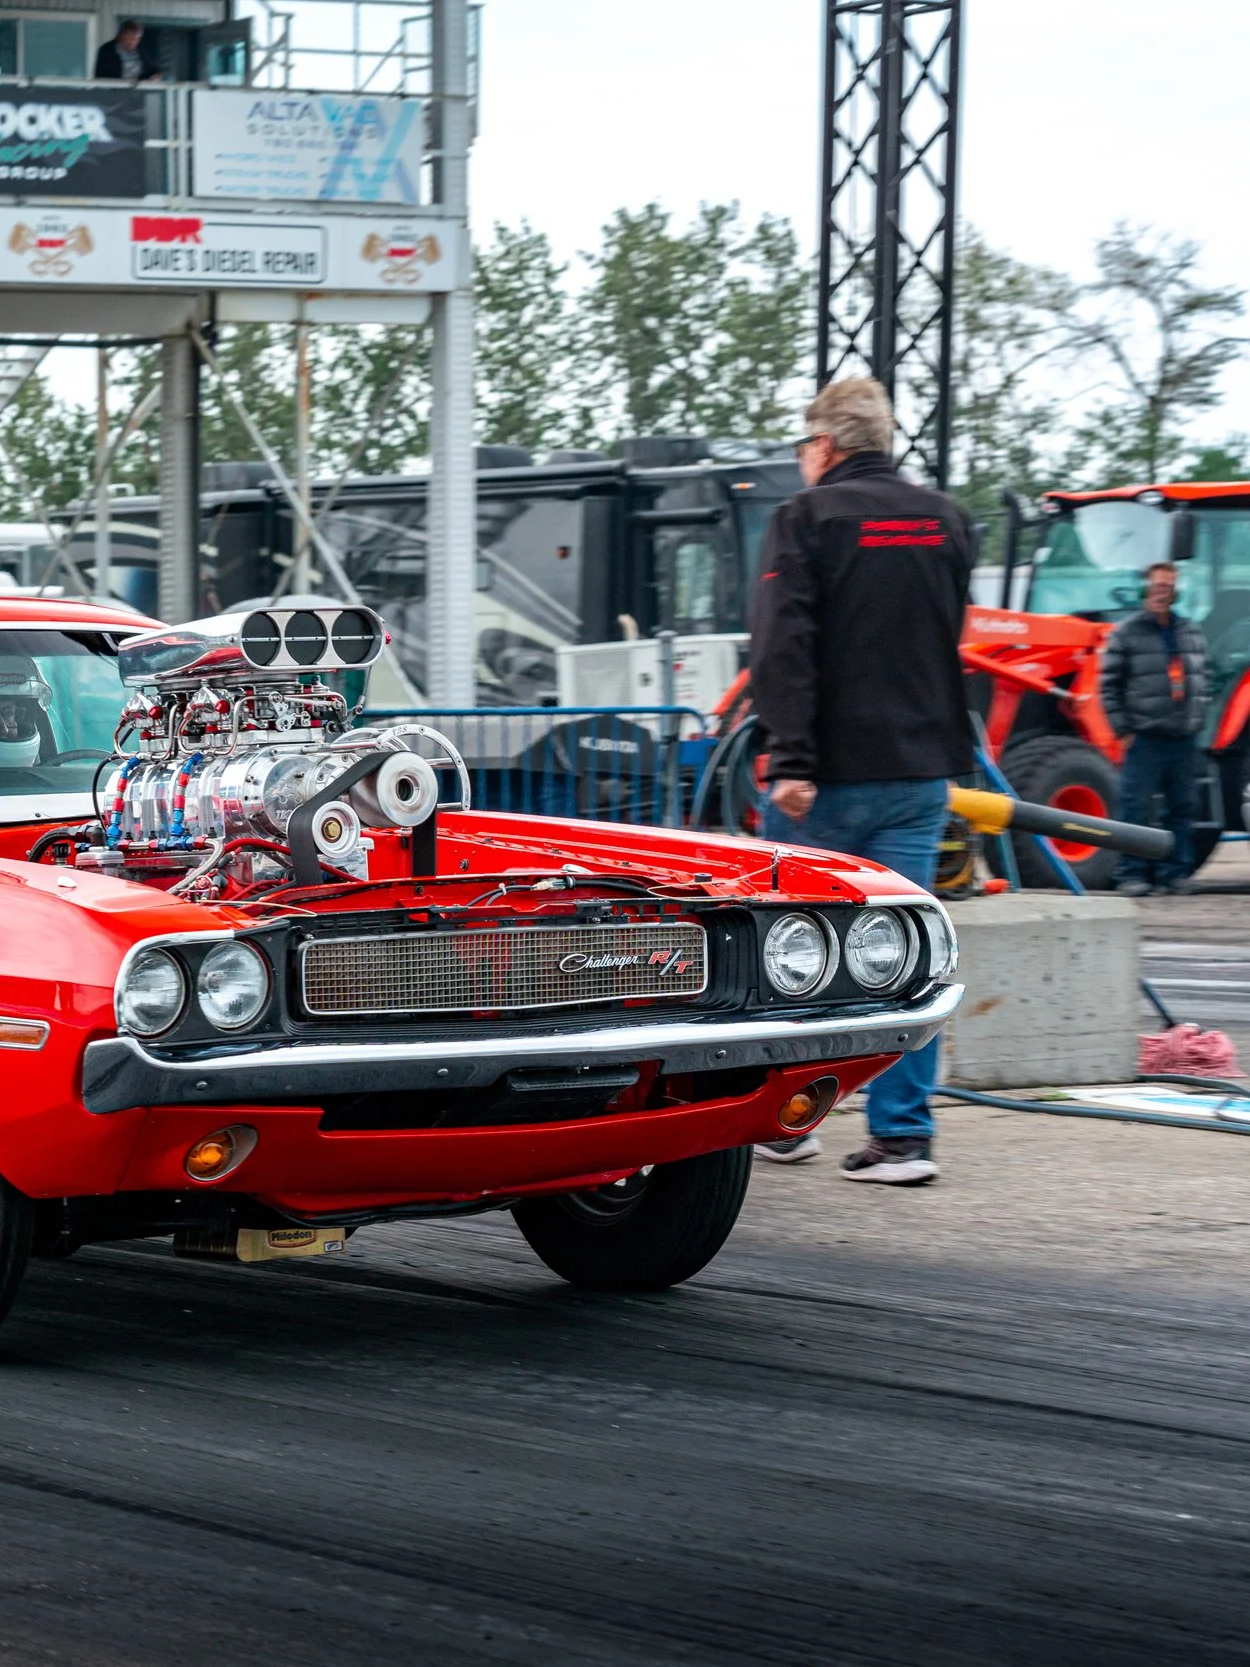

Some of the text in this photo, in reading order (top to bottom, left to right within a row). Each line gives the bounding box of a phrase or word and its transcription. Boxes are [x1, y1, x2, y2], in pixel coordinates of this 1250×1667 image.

[141, 248, 319, 275] DAVE'S DIESEL REPAIR
[559, 949, 693, 976] Challenger R/T
[271, 1230, 312, 1242] Milodon
